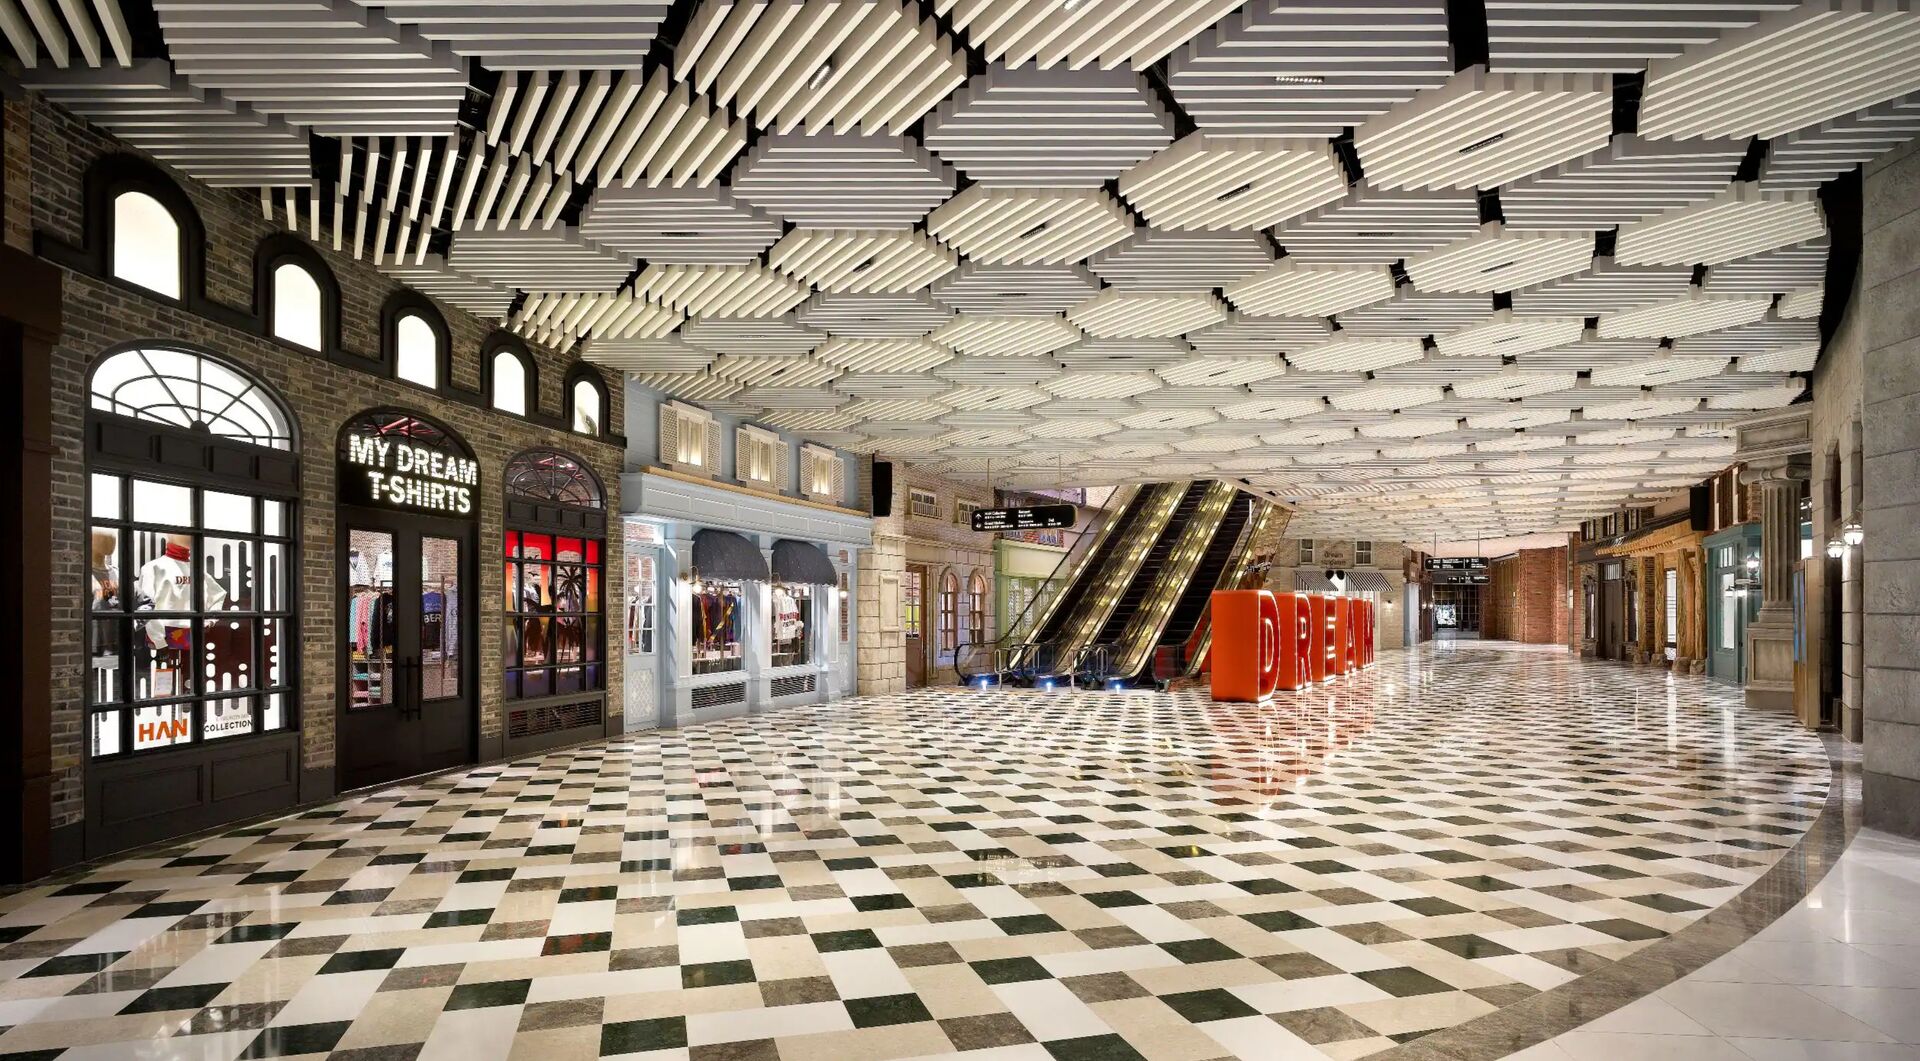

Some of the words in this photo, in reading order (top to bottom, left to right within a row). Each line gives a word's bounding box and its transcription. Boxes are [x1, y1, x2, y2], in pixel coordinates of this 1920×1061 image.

[349, 434, 390, 468] MY
[397, 443, 477, 486] DREAM
[367, 471, 471, 513] T-SHIRTS
[1238, 590, 1374, 702] DREAM
[138, 718, 188, 743] HAN
[203, 719, 253, 733] COLLECTION
